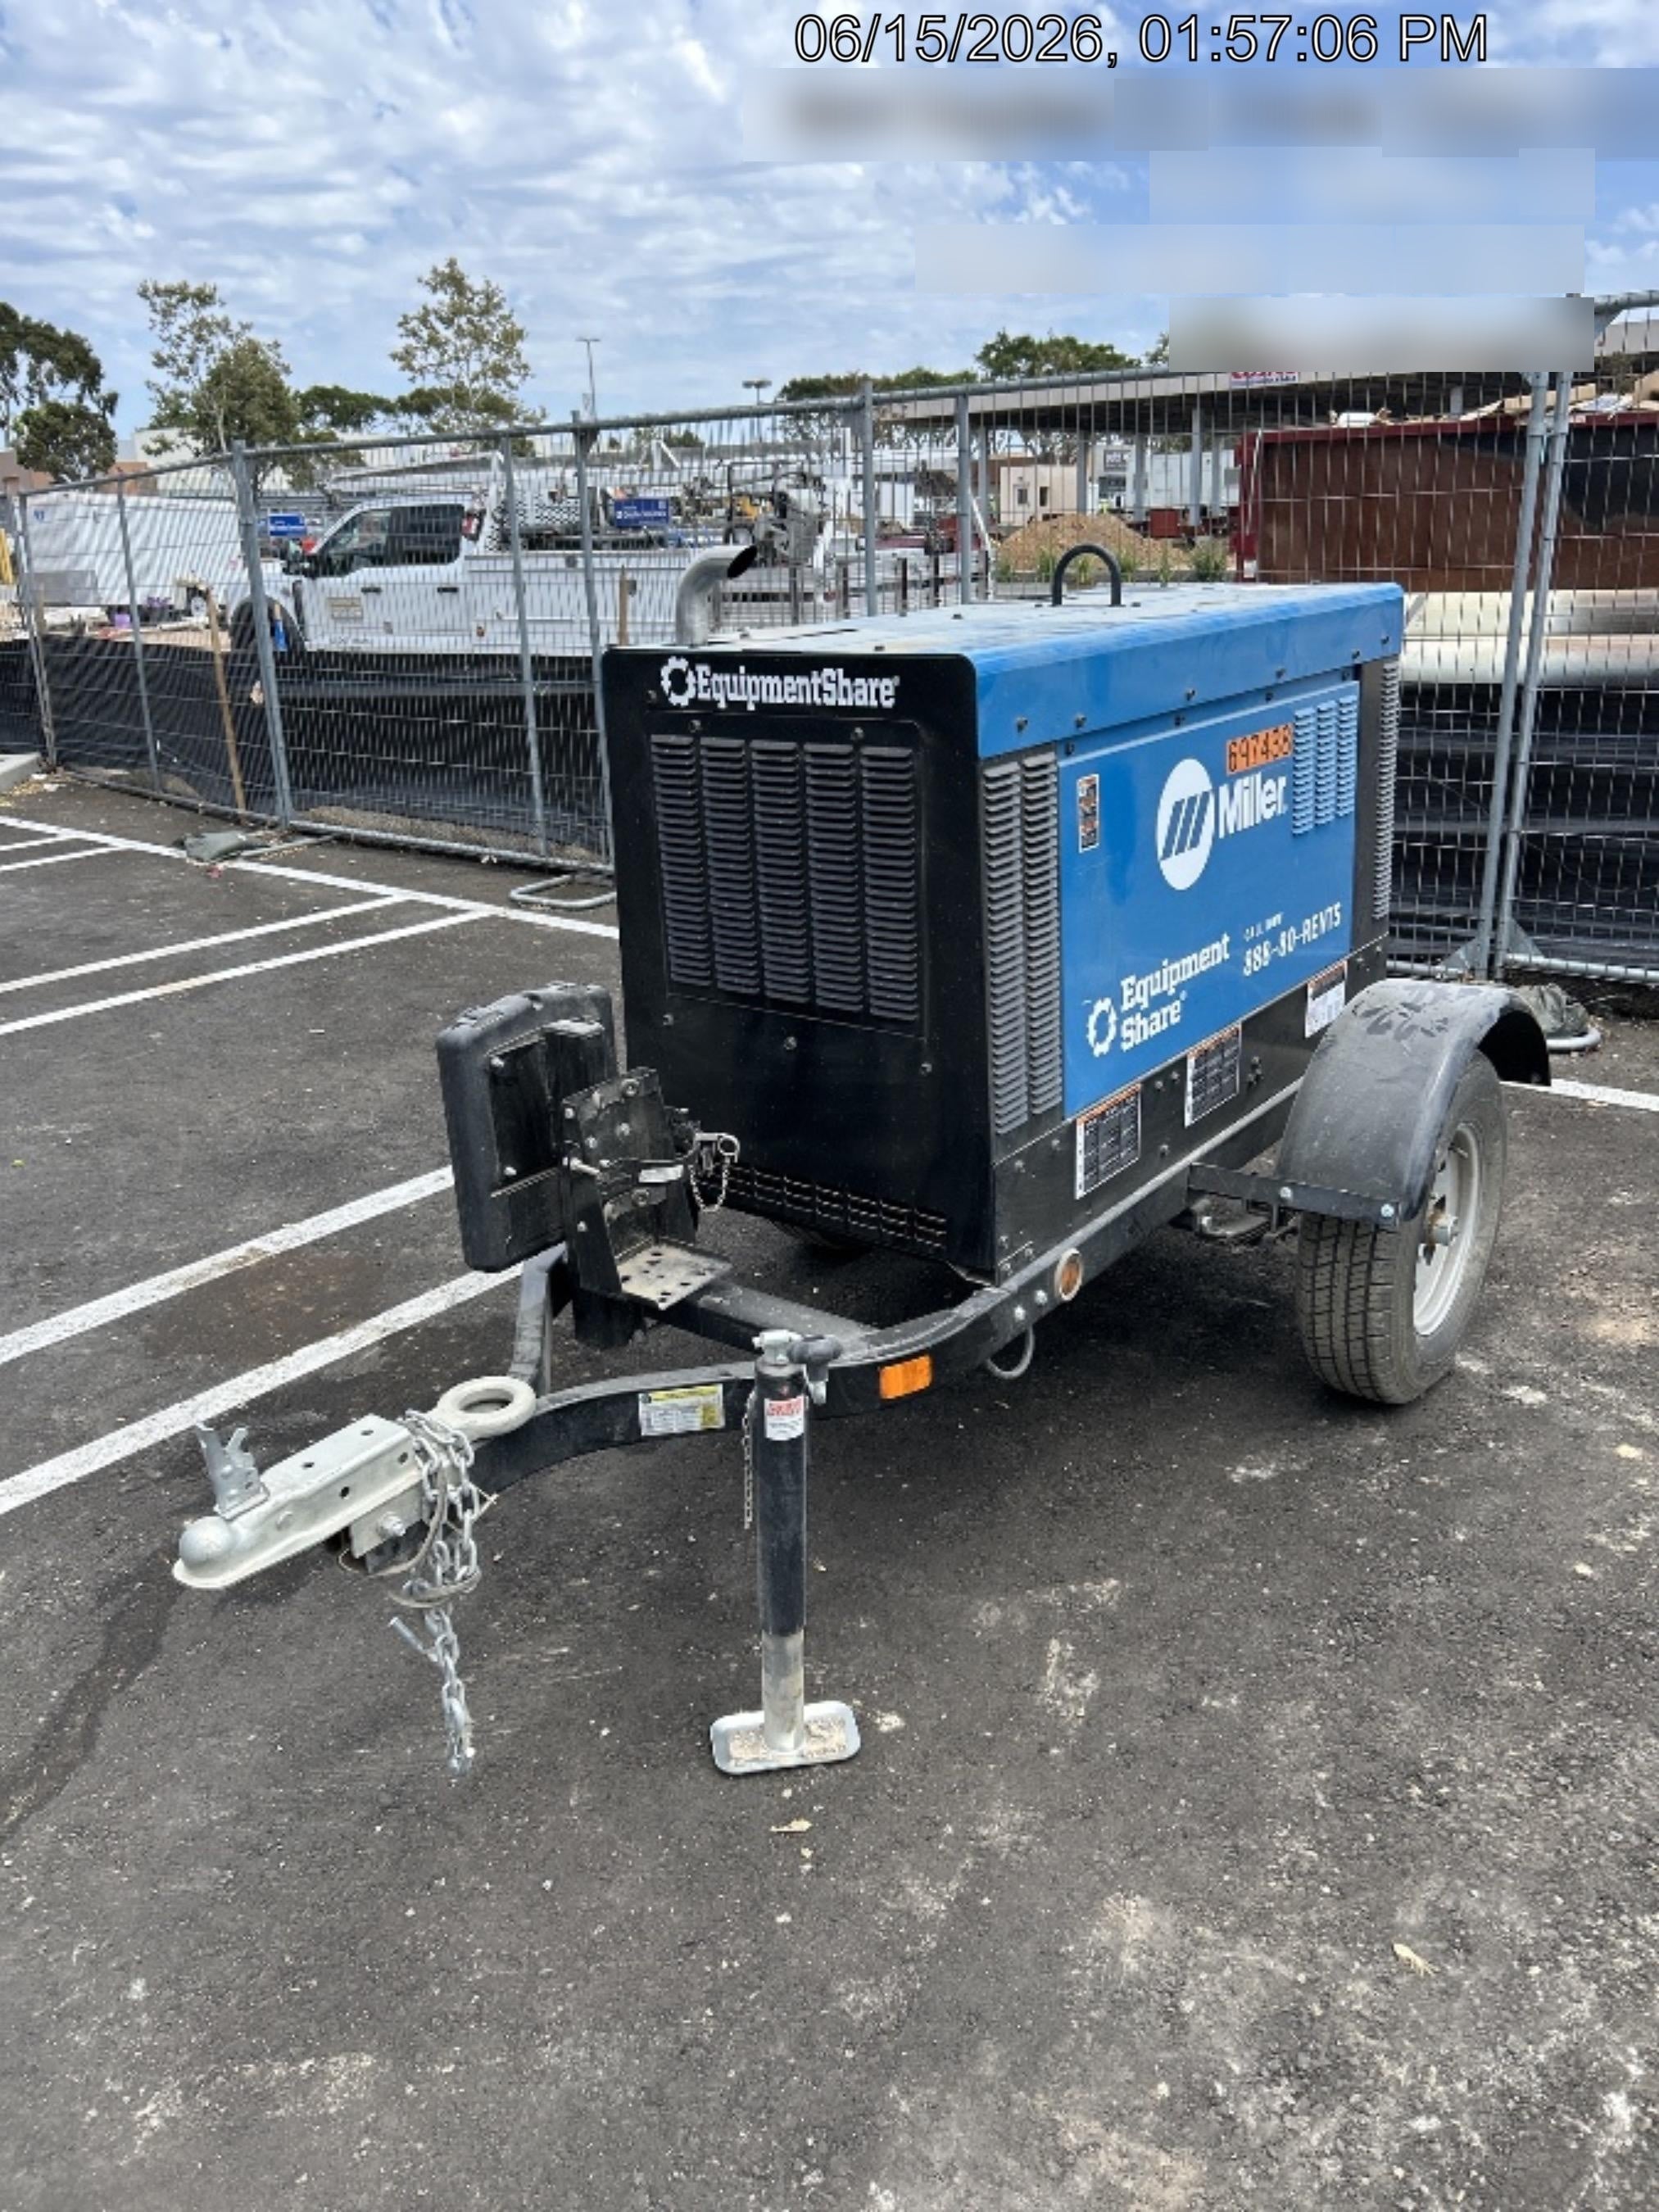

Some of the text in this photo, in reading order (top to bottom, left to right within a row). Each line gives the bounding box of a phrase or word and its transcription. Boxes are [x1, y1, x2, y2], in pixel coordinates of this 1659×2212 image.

[696, 664, 896, 711] EquipmentShare
[1218, 771, 1286, 839] Miller
[1120, 931, 1231, 1012] Equipment
[1120, 998, 1181, 1054] Share
